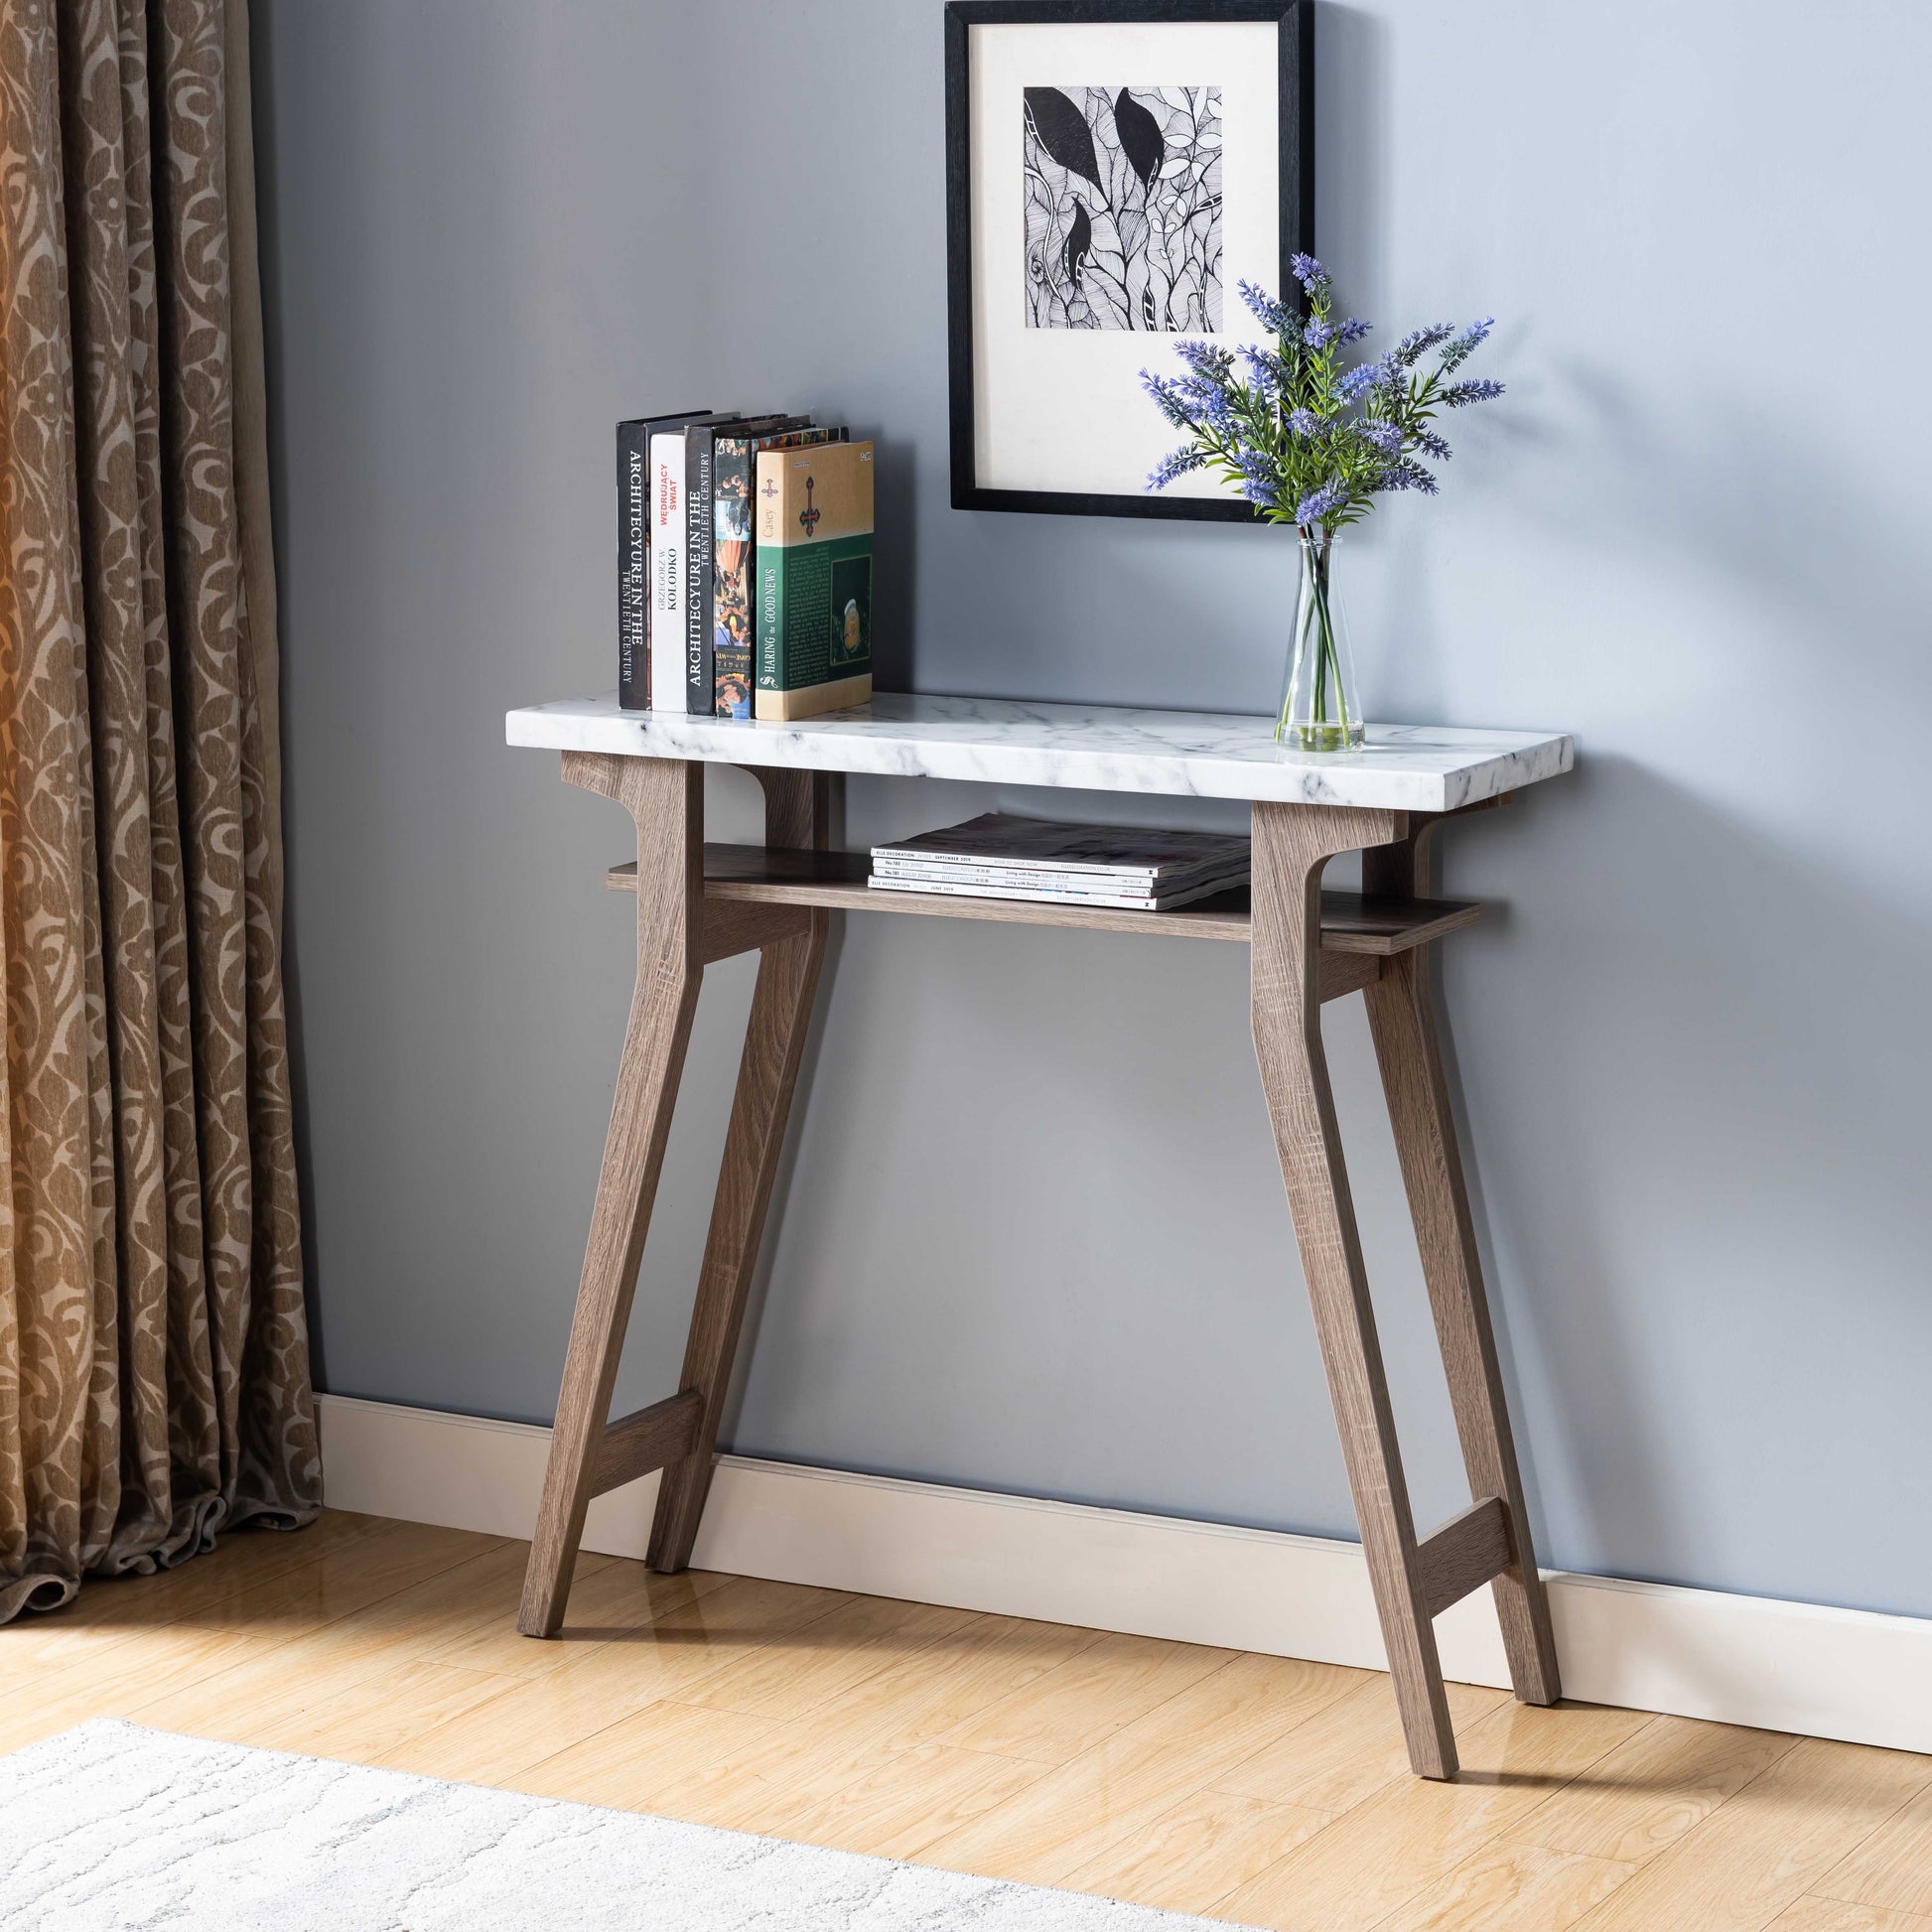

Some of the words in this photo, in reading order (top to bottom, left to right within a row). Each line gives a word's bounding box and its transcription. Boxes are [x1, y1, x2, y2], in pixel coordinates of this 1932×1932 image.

[700, 452, 710, 500] CENTURY
[629, 450, 642, 584] ARCHITECYURE
[689, 490, 701, 527] THE
[762, 509, 776, 538] Casey
[689, 531, 701, 550] IN
[700, 504, 710, 567] TWENTIETH
[621, 570, 631, 631] TWENTIETH
[631, 588, 642, 606] IN
[764, 568, 776, 596] NEWS
[631, 612, 643, 645] THE
[689, 553, 701, 687] ARCHITECYURE
[764, 597, 776, 623] GOOD
[622, 635, 632, 683] CENTURY
